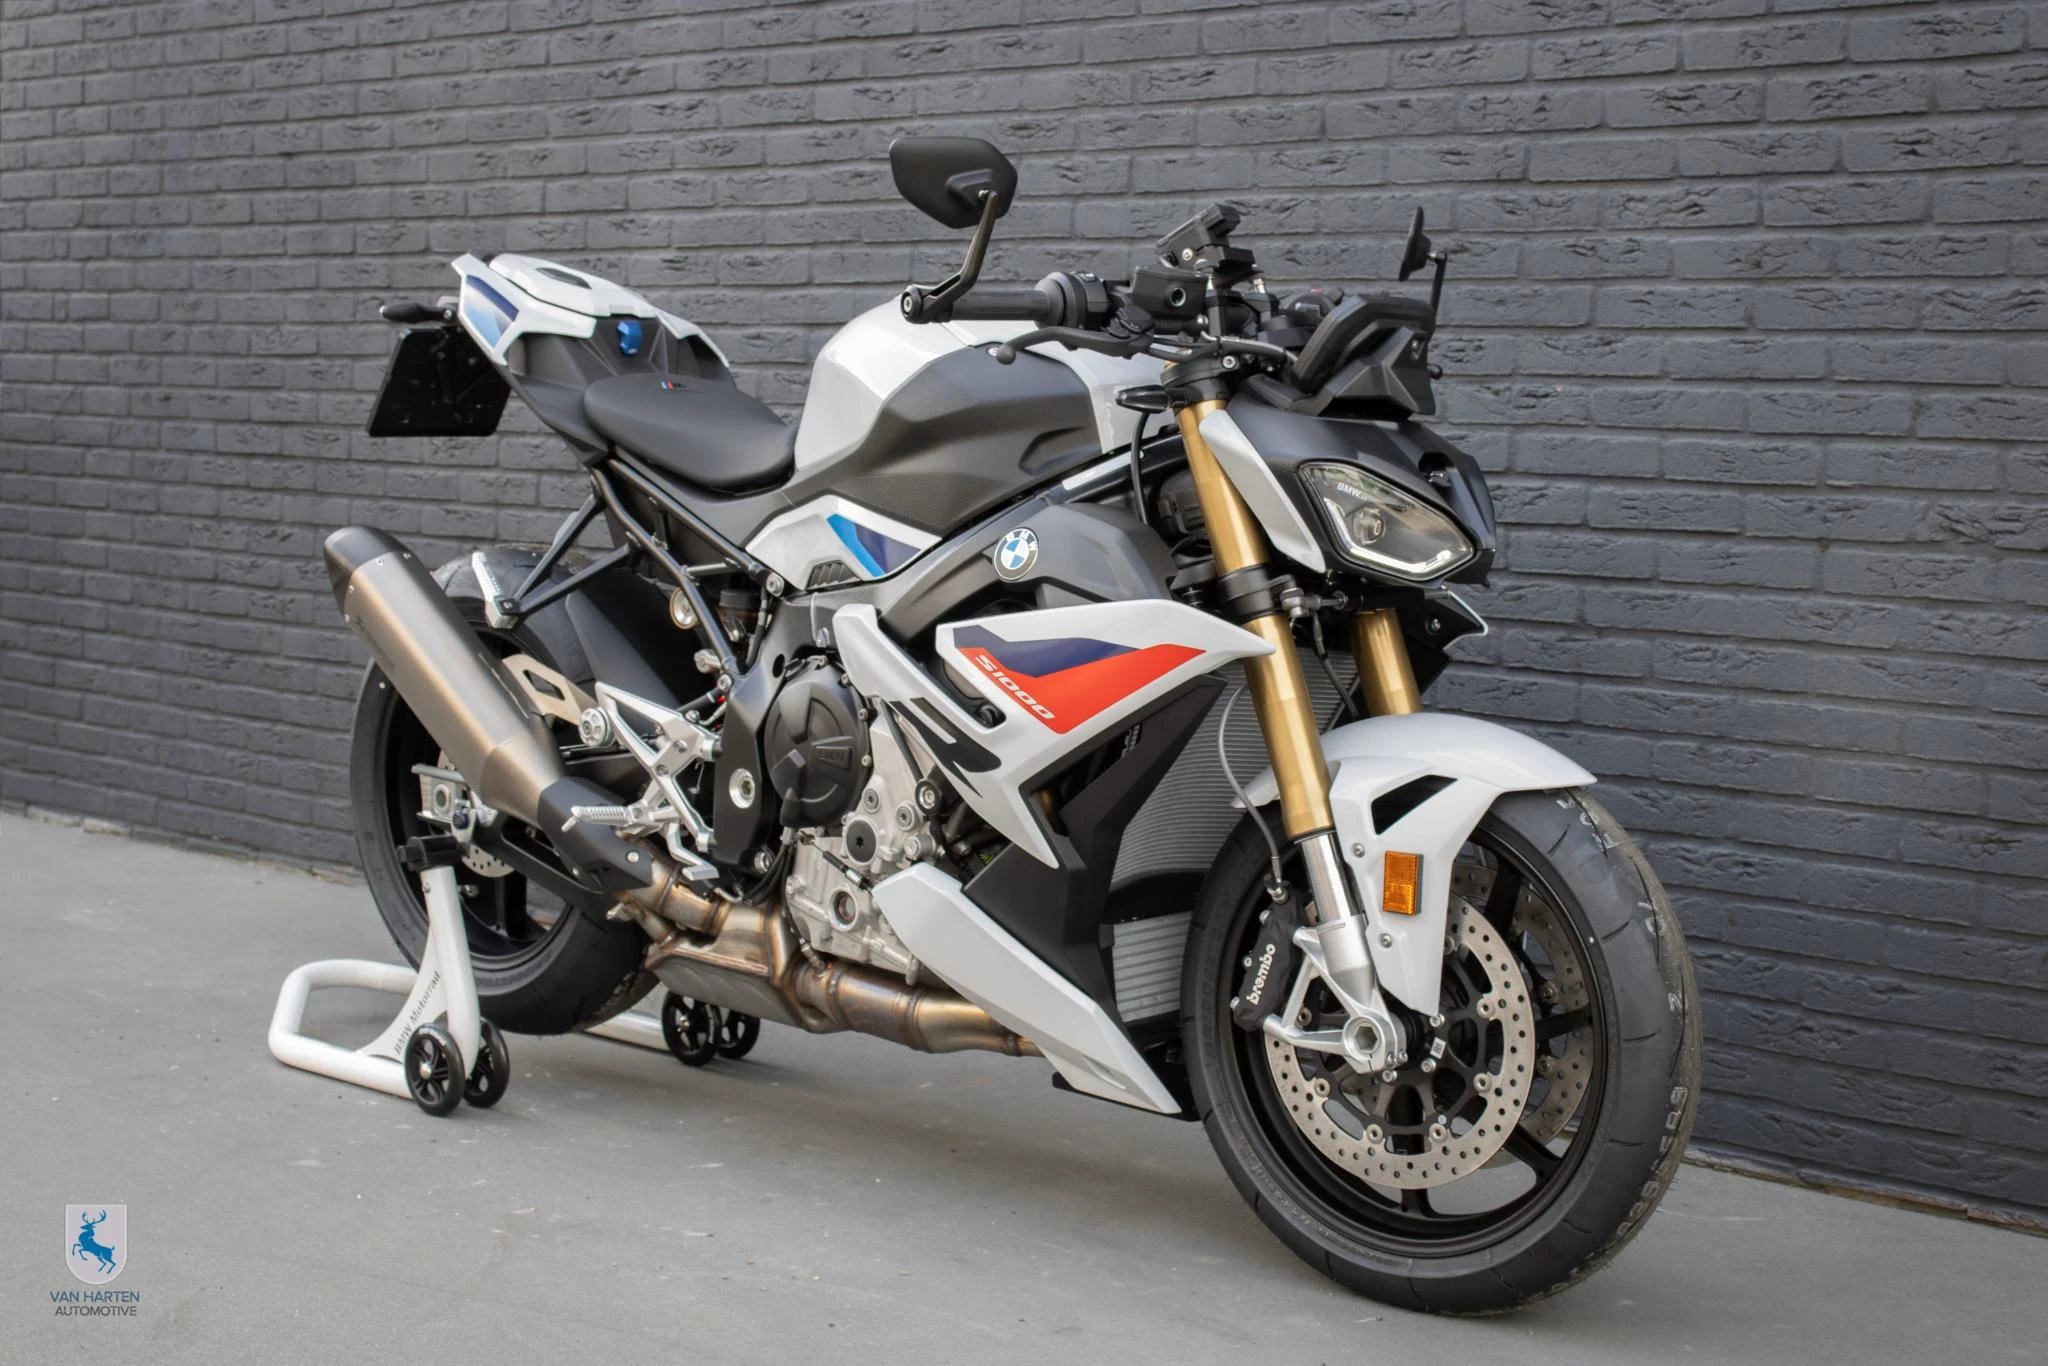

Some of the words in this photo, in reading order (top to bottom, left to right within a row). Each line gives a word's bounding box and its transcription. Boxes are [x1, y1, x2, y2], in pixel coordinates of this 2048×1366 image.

[1337, 483, 1360, 498] BMW
[1005, 529, 1038, 551] BMW
[975, 654, 1055, 720] S1000
[410, 970, 442, 1025] Motorrad
[1246, 943, 1276, 1006] brembo
